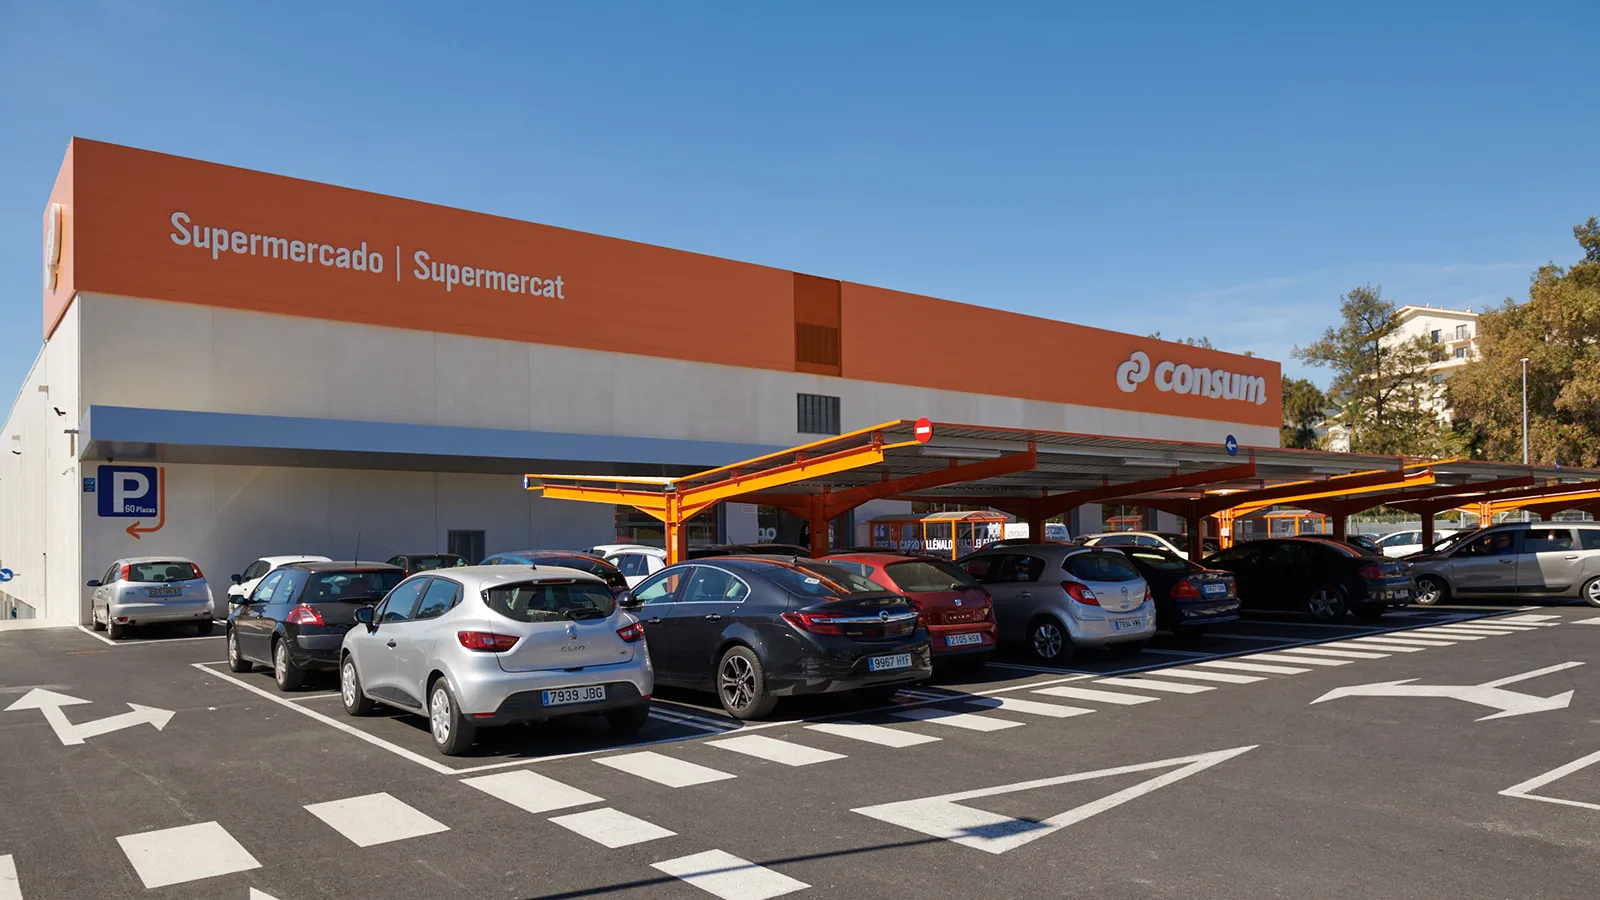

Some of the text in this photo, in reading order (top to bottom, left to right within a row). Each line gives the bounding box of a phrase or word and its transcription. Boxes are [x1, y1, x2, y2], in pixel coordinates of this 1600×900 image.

[169, 211, 565, 299] Supermercado Supermercat
[1153, 361, 1267, 405] consum
[113, 471, 150, 513] P
[125, 504, 136, 513] 60
[926, 537, 953, 550] LLÉNALO
[950, 635, 968, 644] 2105
[560, 645, 585, 653] CLIO
[874, 656, 895, 668] 9967
[550, 687, 603, 704] 7939 JBG
